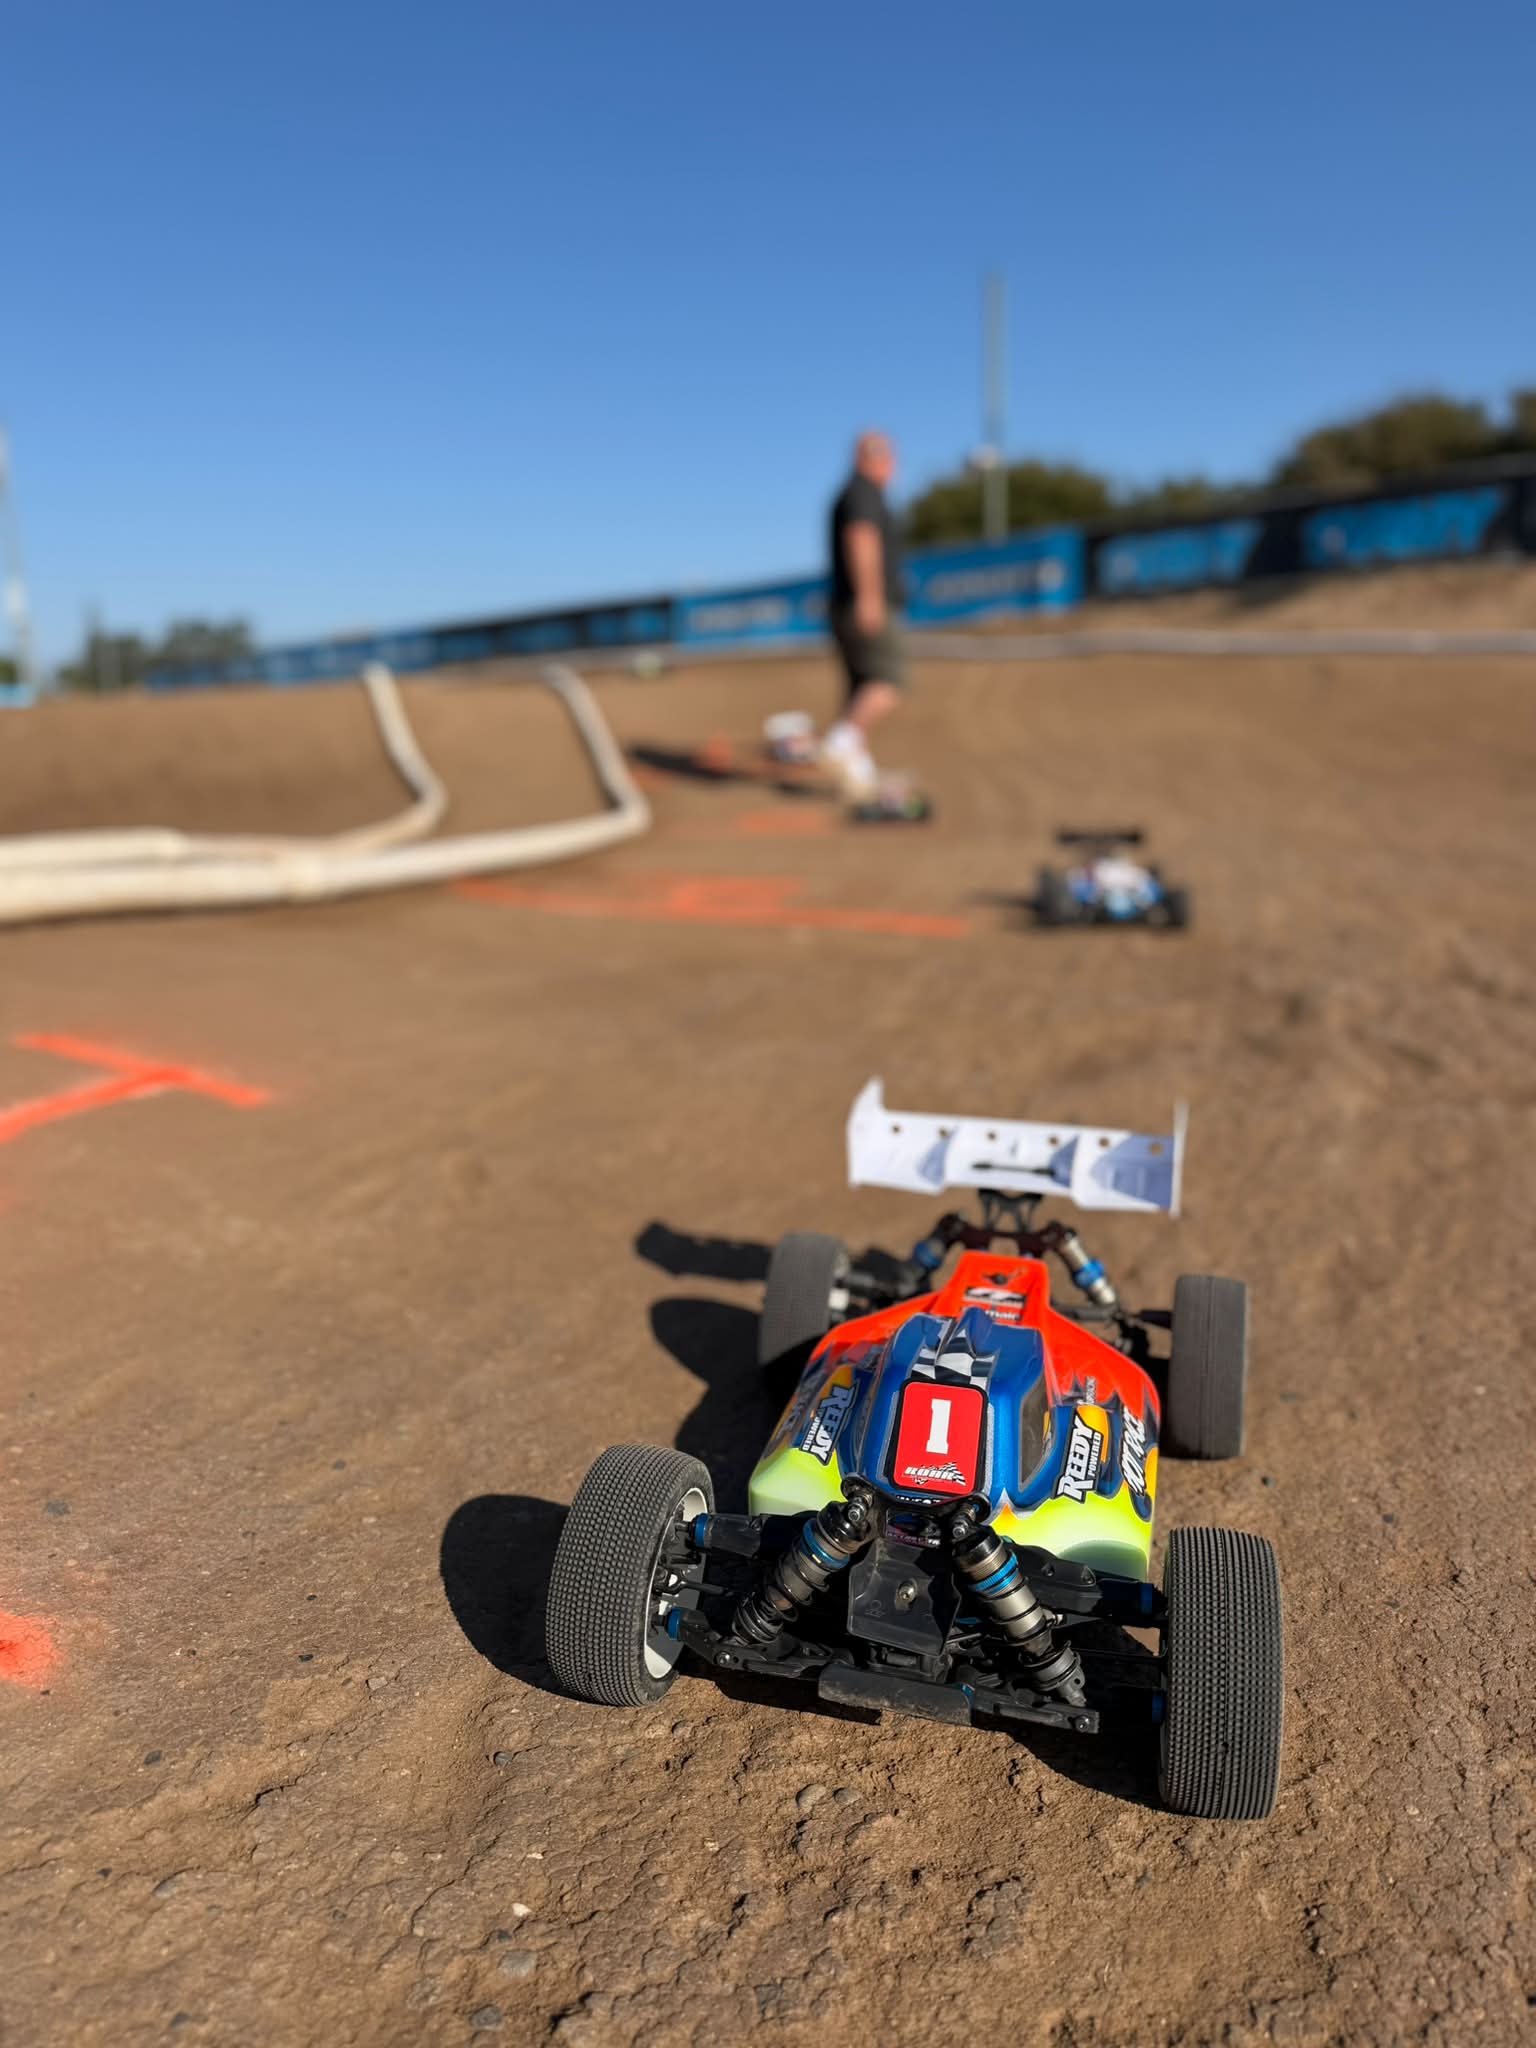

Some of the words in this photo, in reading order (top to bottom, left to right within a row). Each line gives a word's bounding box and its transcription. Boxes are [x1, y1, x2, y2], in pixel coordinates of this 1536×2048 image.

[810, 1385, 856, 1461] REEDY
[926, 1398, 952, 1455] 1
[1087, 1431, 1102, 1477] POWERED
[1056, 1415, 1094, 1501] REEDY
